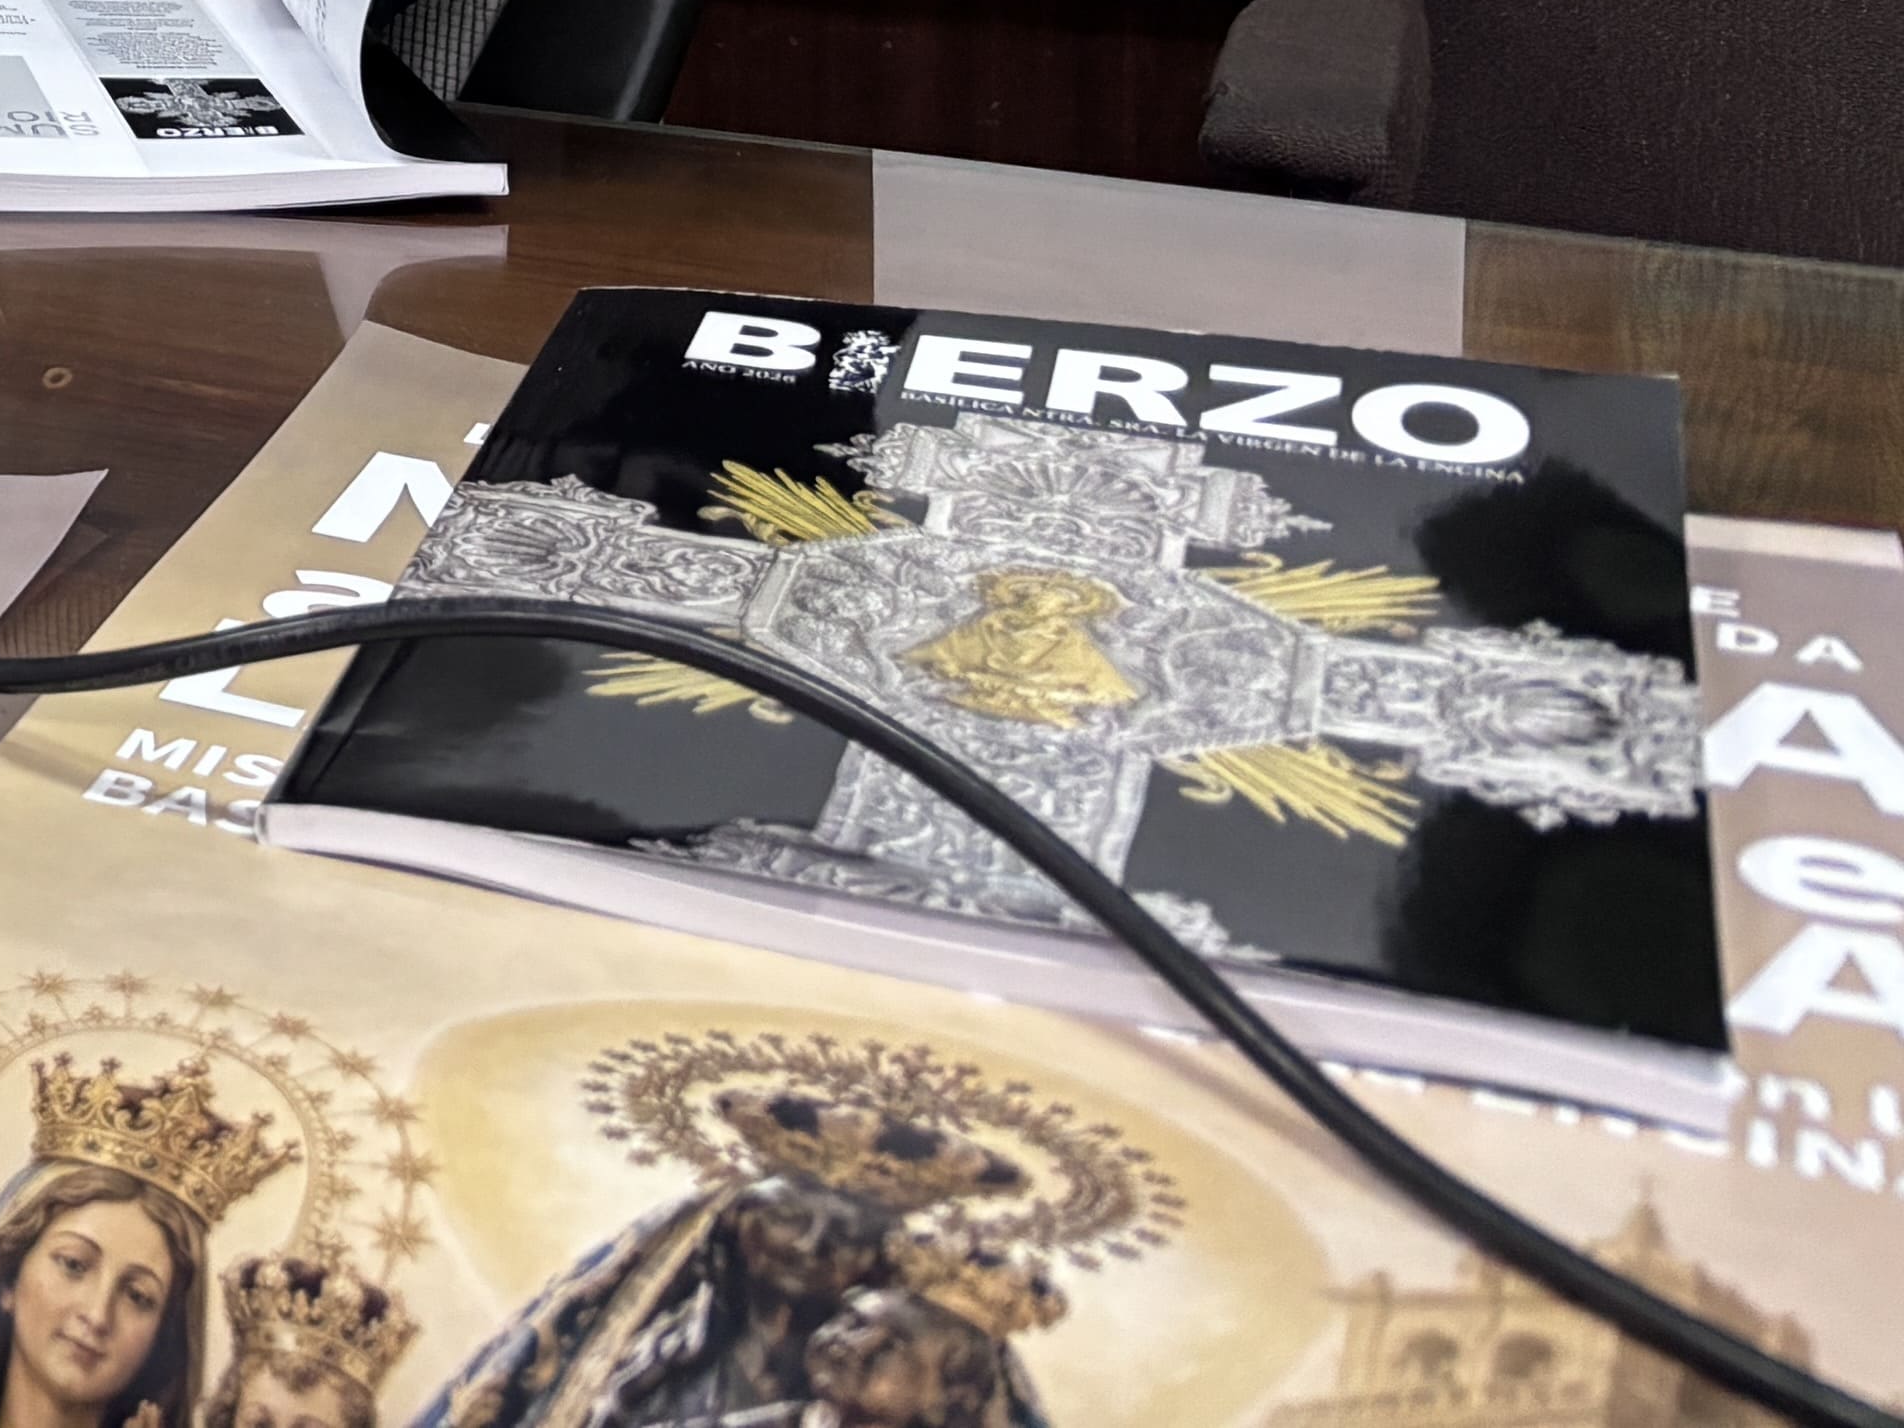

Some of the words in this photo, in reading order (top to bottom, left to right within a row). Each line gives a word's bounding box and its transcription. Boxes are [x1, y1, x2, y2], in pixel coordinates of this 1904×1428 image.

[6, 110, 93, 124] RIO
[683, 309, 1531, 464] BIERZO
[742, 366, 797, 384] 2026
[1717, 621, 1865, 674] DA
[115, 727, 286, 789] MIS
